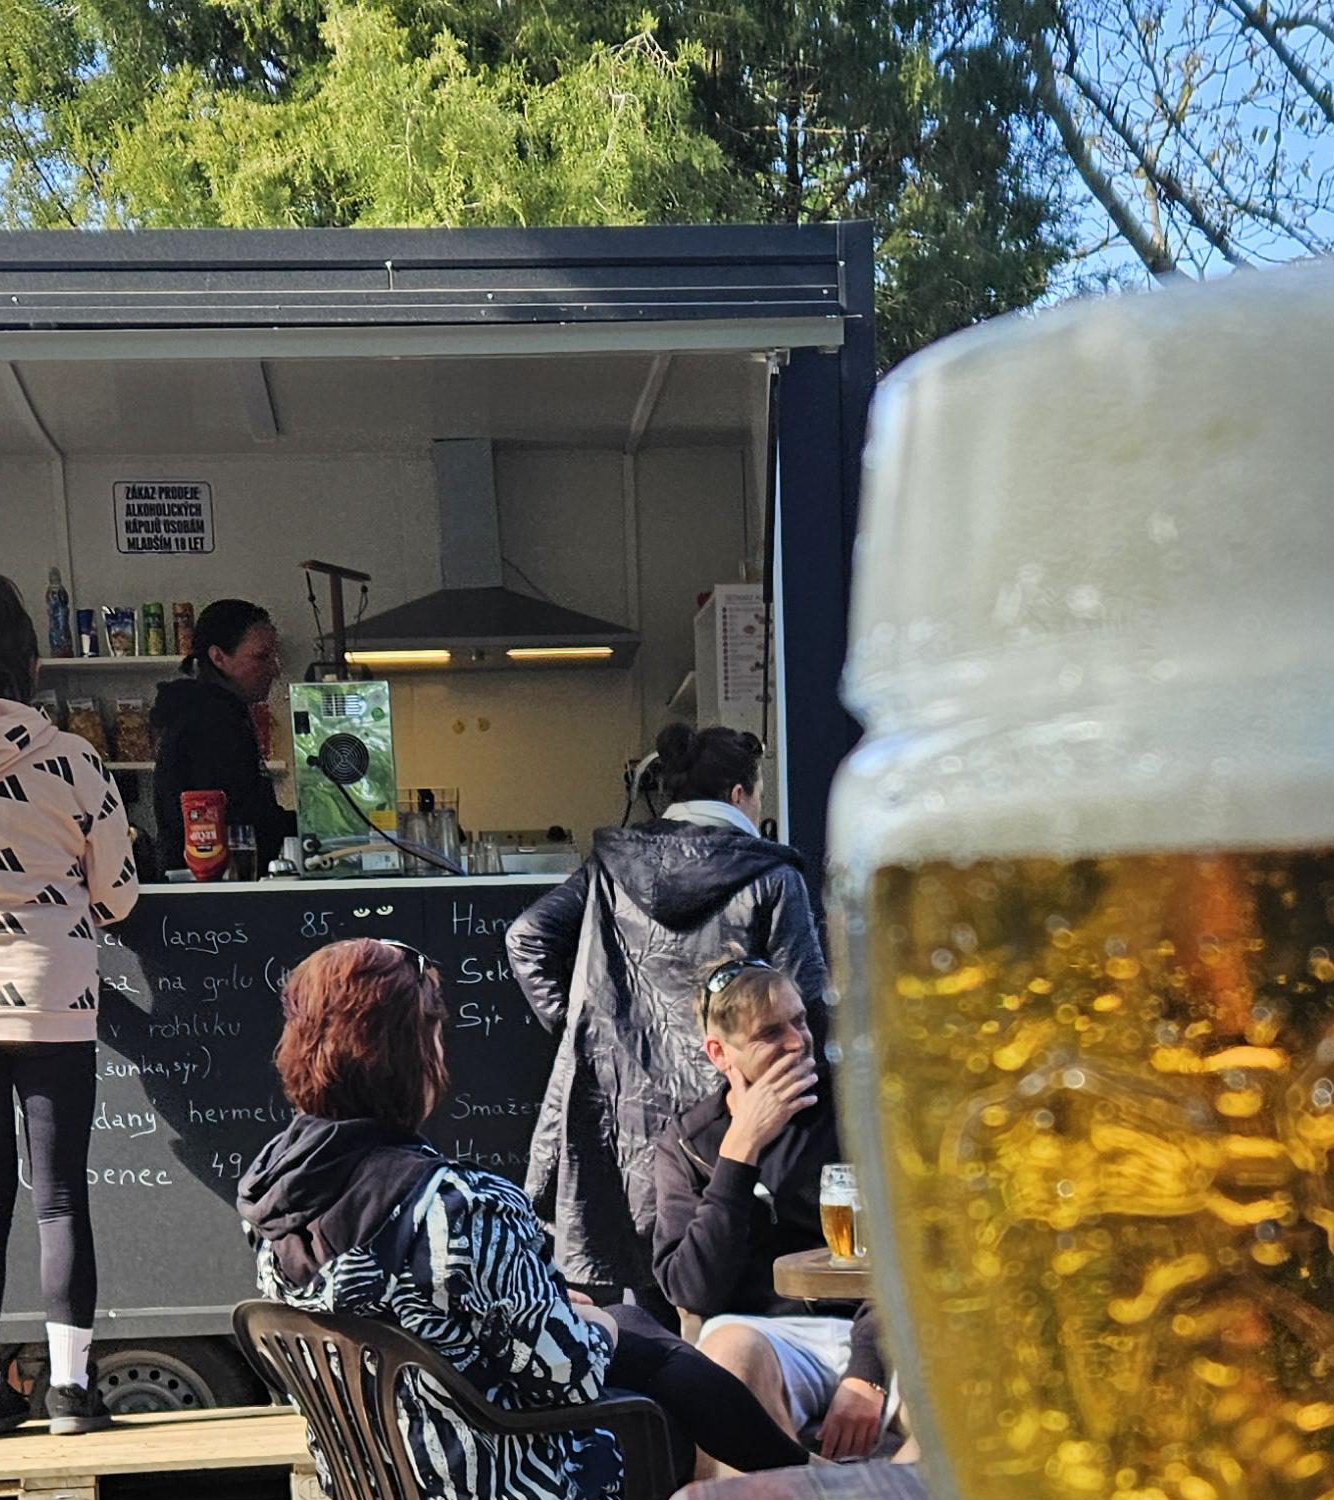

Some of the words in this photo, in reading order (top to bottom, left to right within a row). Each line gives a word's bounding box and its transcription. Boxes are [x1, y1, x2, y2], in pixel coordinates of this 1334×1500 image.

[125, 485, 157, 500] ZÁKAZ
[158, 486, 201, 500] PRODEJE
[125, 501, 202, 517] ALKOHOLICKÝCH
[125, 517, 162, 534] NÁPOJŮ
[163, 518, 204, 533] OSOBÁM
[127, 535, 172, 550] MLADŠÍM
[175, 537, 186, 550] 18
[188, 537, 204, 550] LET
[162, 916, 249, 954] langoš
[456, 957, 509, 984] Sek
[158, 976, 186, 991] na
[202, 964, 254, 1001] grilu
